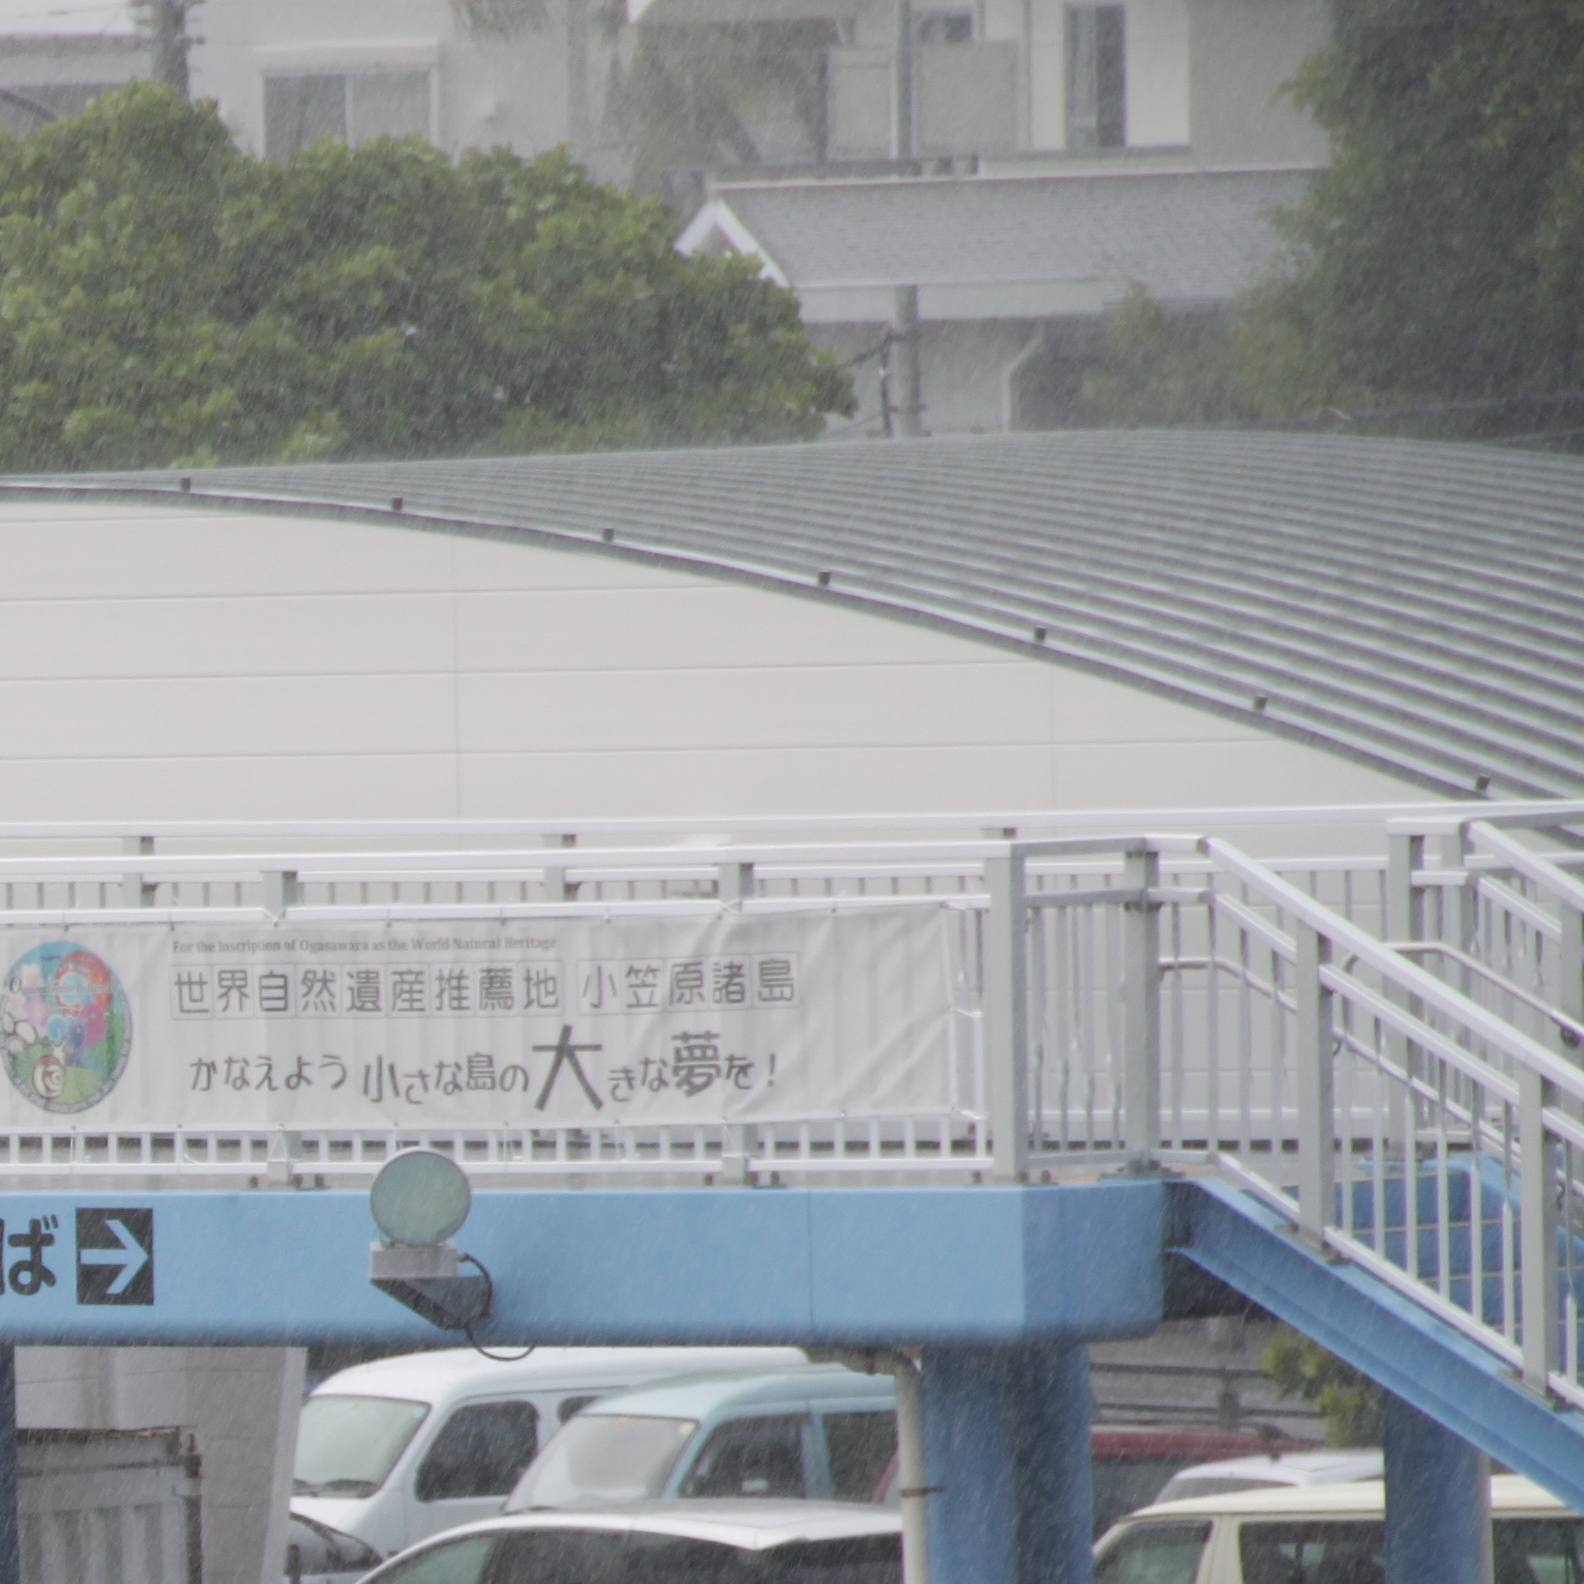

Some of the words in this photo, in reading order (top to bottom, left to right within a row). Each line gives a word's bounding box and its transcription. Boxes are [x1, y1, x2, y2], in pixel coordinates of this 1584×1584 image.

[196, 940, 214, 952] the
[300, 939, 369, 955] Ogasawara
[388, 939, 407, 951] the
[411, 938, 450, 951] World
[453, 937, 500, 950] Natural
[503, 936, 558, 953] Heritage
[173, 966, 560, 1014] 世界自然遺産推薦地
[582, 958, 794, 1009] 小笠原諸島
[190, 1054, 348, 1093] かなえよう
